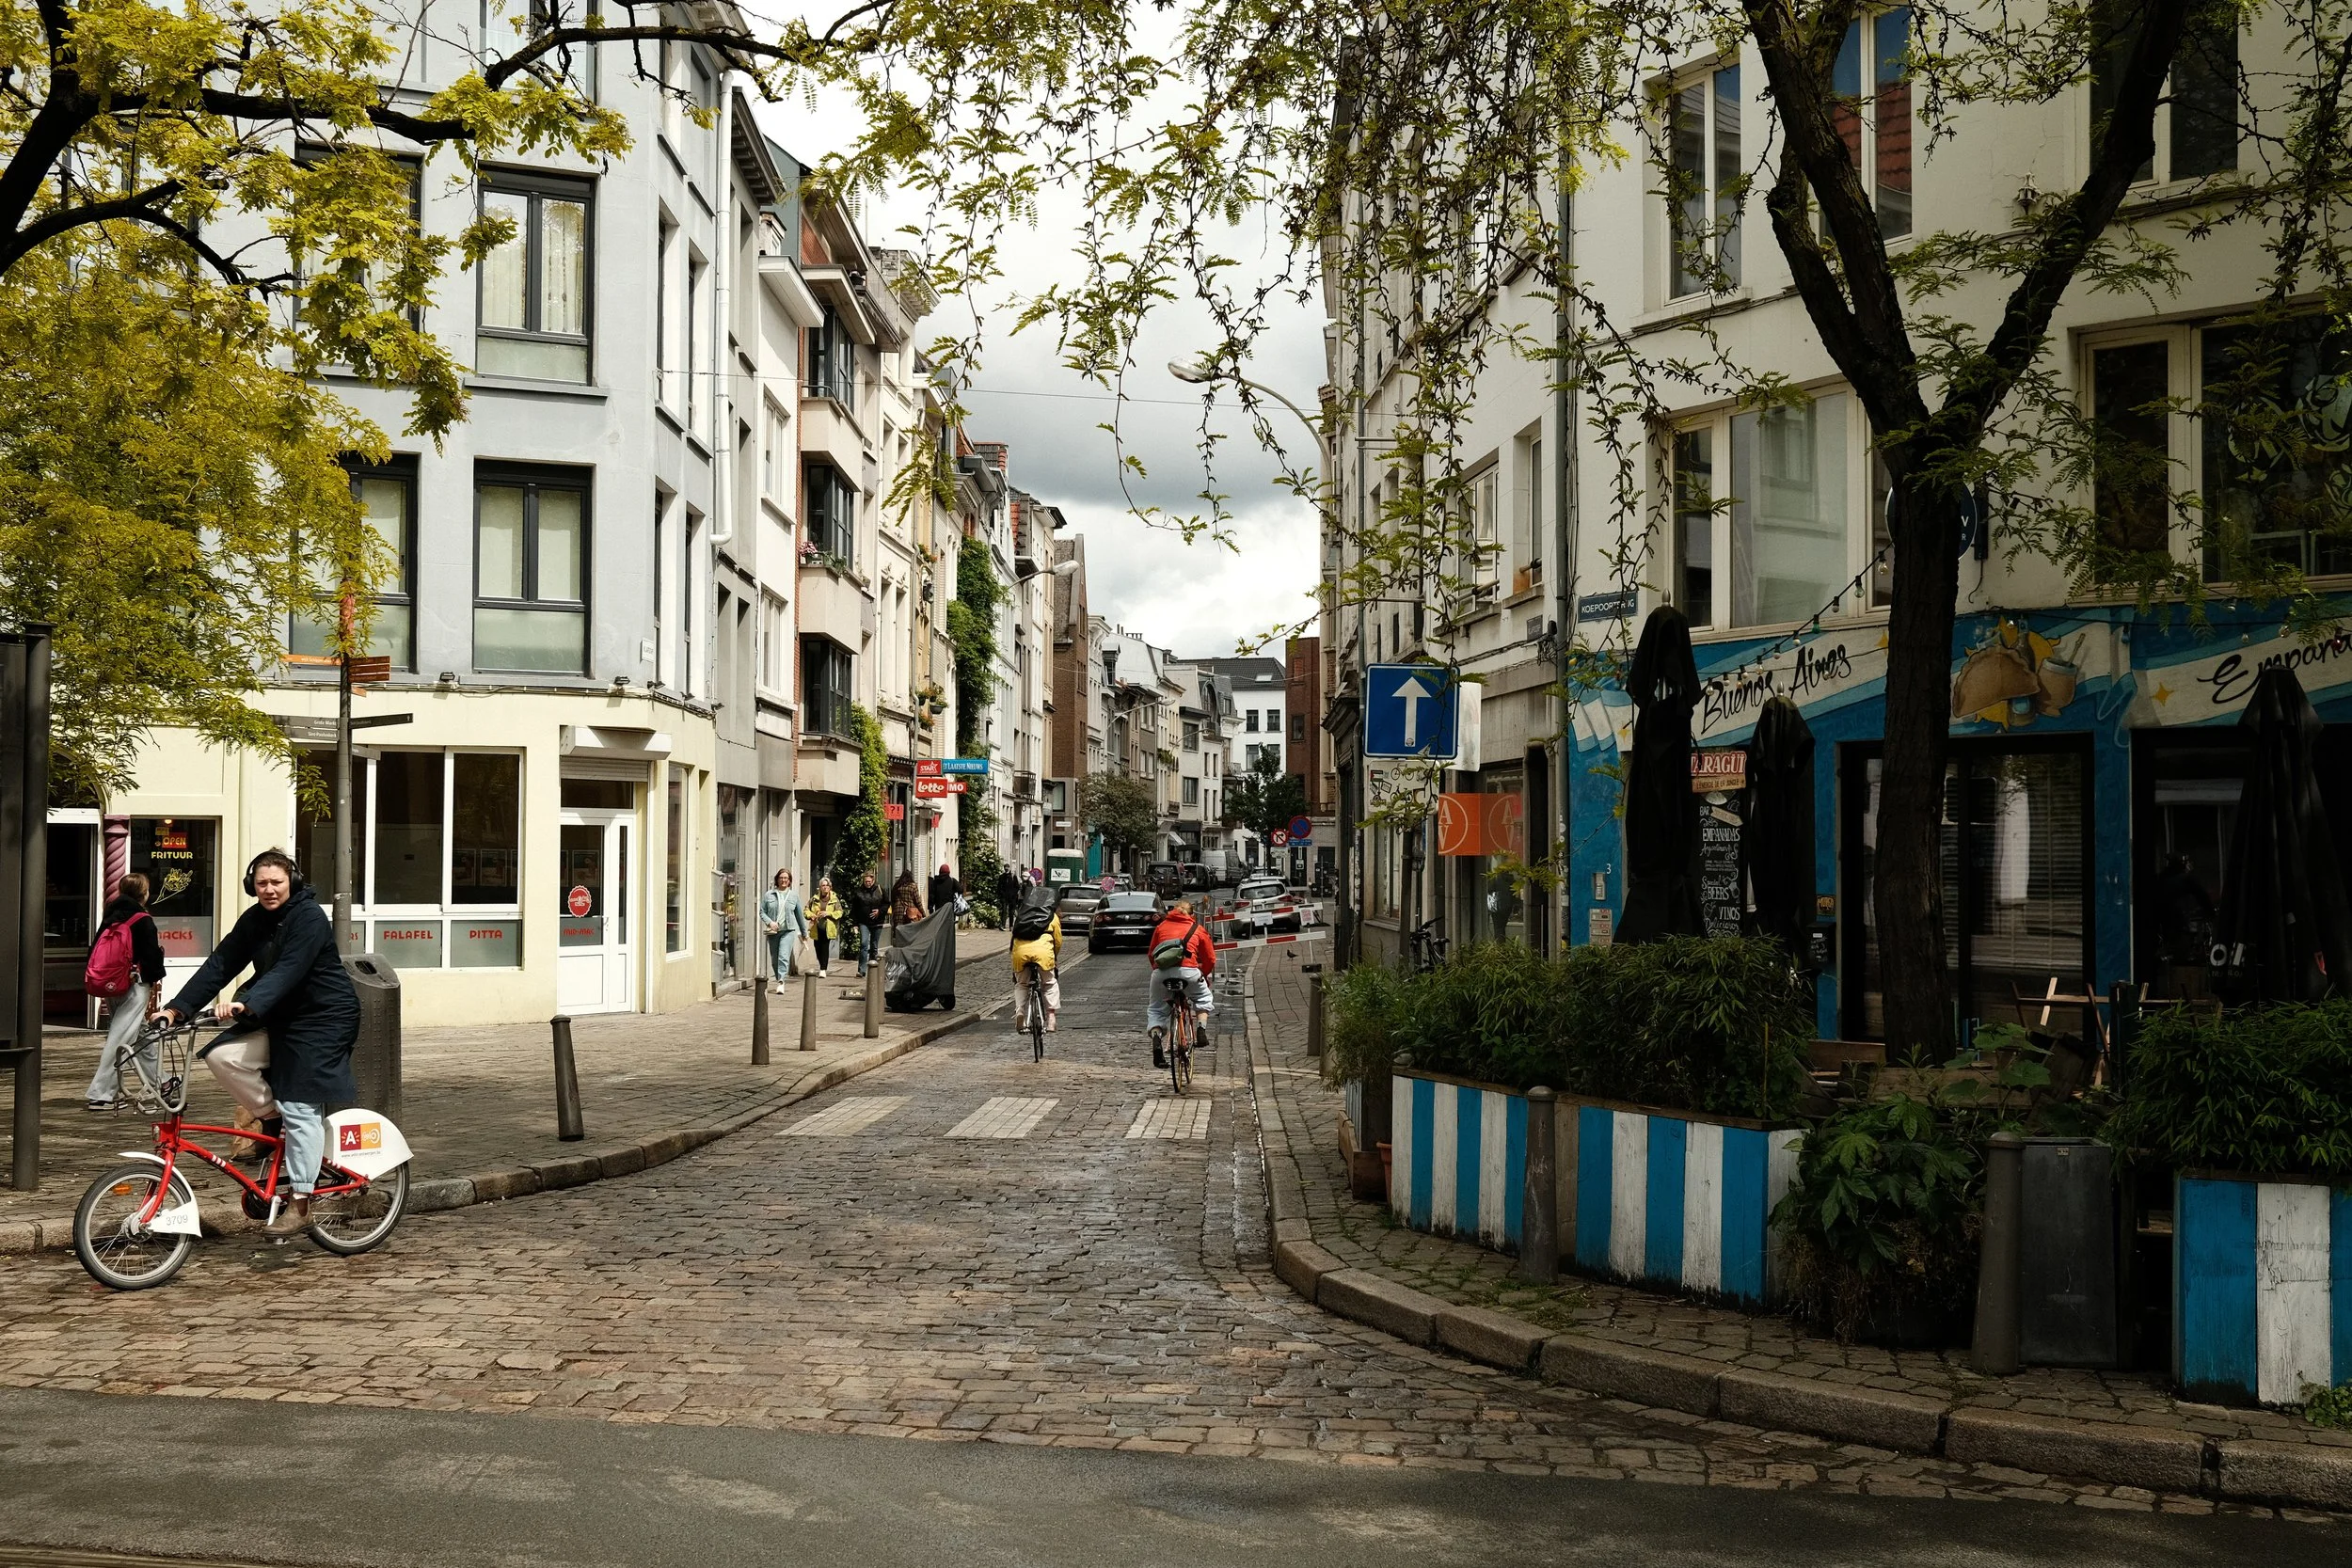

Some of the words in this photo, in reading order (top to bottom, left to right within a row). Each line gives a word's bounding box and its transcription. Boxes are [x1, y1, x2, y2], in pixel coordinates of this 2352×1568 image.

[1701, 669, 1775, 735] Buenos
[1788, 644, 1851, 699] Aires
[947, 762, 965, 770] LAATSTE
[966, 762, 983, 770] NIEUWS
[917, 782, 945, 793] Lotto
[1699, 805, 1710, 816] BAR
[1702, 828, 1740, 842] EMPANADAS
[163, 836, 186, 846] OPEN
[151, 851, 193, 860] FRITUUR
[1606, 863, 1612, 874] 3
[1708, 886, 1729, 900] BEERS
[1719, 906, 1740, 921] VINOS
[158, 930, 193, 940] ACKS
[383, 929, 433, 940] FALAFEL
[469, 929, 502, 940] PITTA
[166, 1213, 188, 1227] 3709
